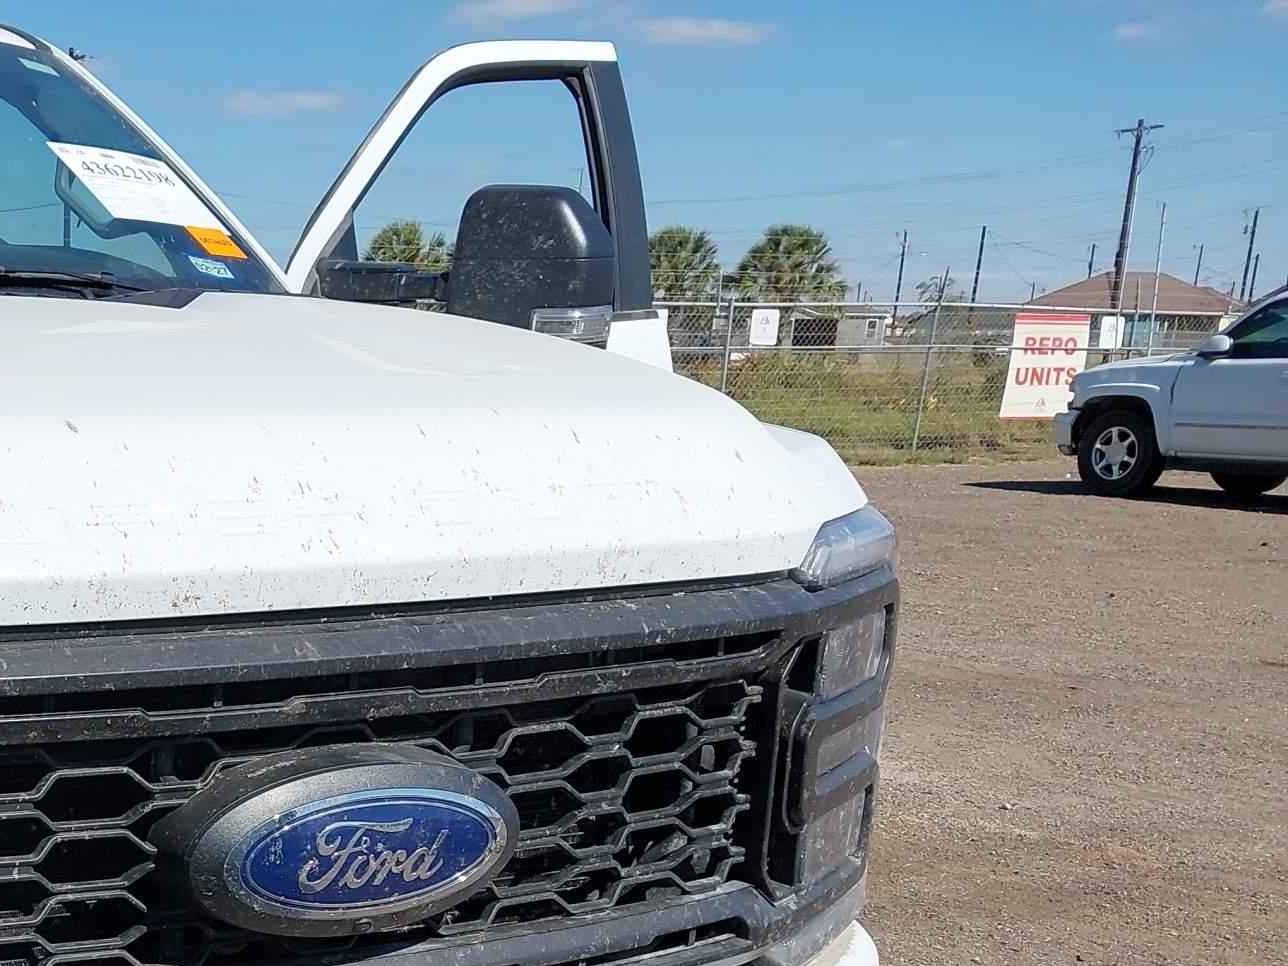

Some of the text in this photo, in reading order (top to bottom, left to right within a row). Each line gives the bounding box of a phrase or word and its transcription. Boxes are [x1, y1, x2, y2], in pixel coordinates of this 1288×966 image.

[81, 160, 176, 187] 43622198
[1023, 336, 1078, 356] REPO
[1015, 367, 1077, 386] UNITS
[298, 817, 449, 894] Ford
